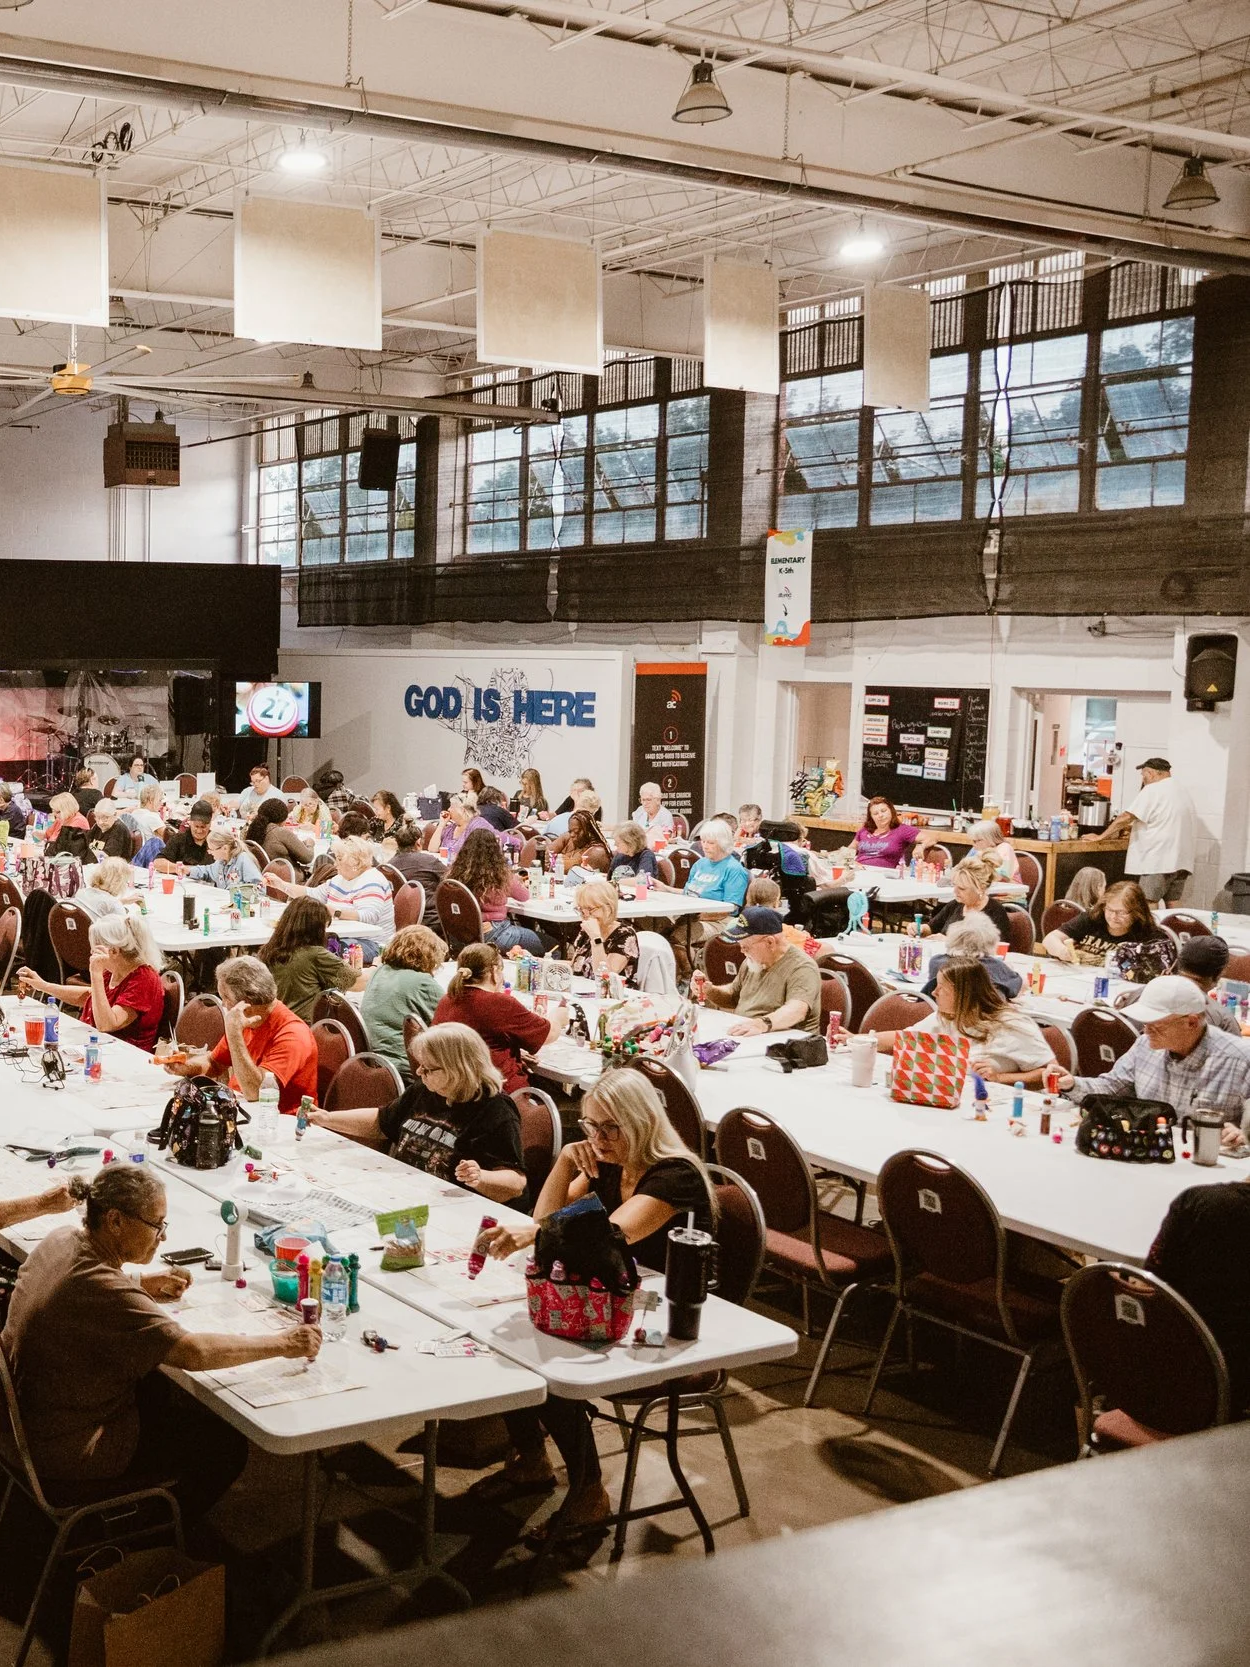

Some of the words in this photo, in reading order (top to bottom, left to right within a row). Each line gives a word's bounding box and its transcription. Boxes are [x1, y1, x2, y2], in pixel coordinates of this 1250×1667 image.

[260, 697, 290, 720] 27
[404, 684, 462, 720] GOD
[473, 687, 501, 723] IS
[512, 689, 597, 728] HERE
[667, 700, 677, 709] ac
[667, 778, 672, 788] 2
